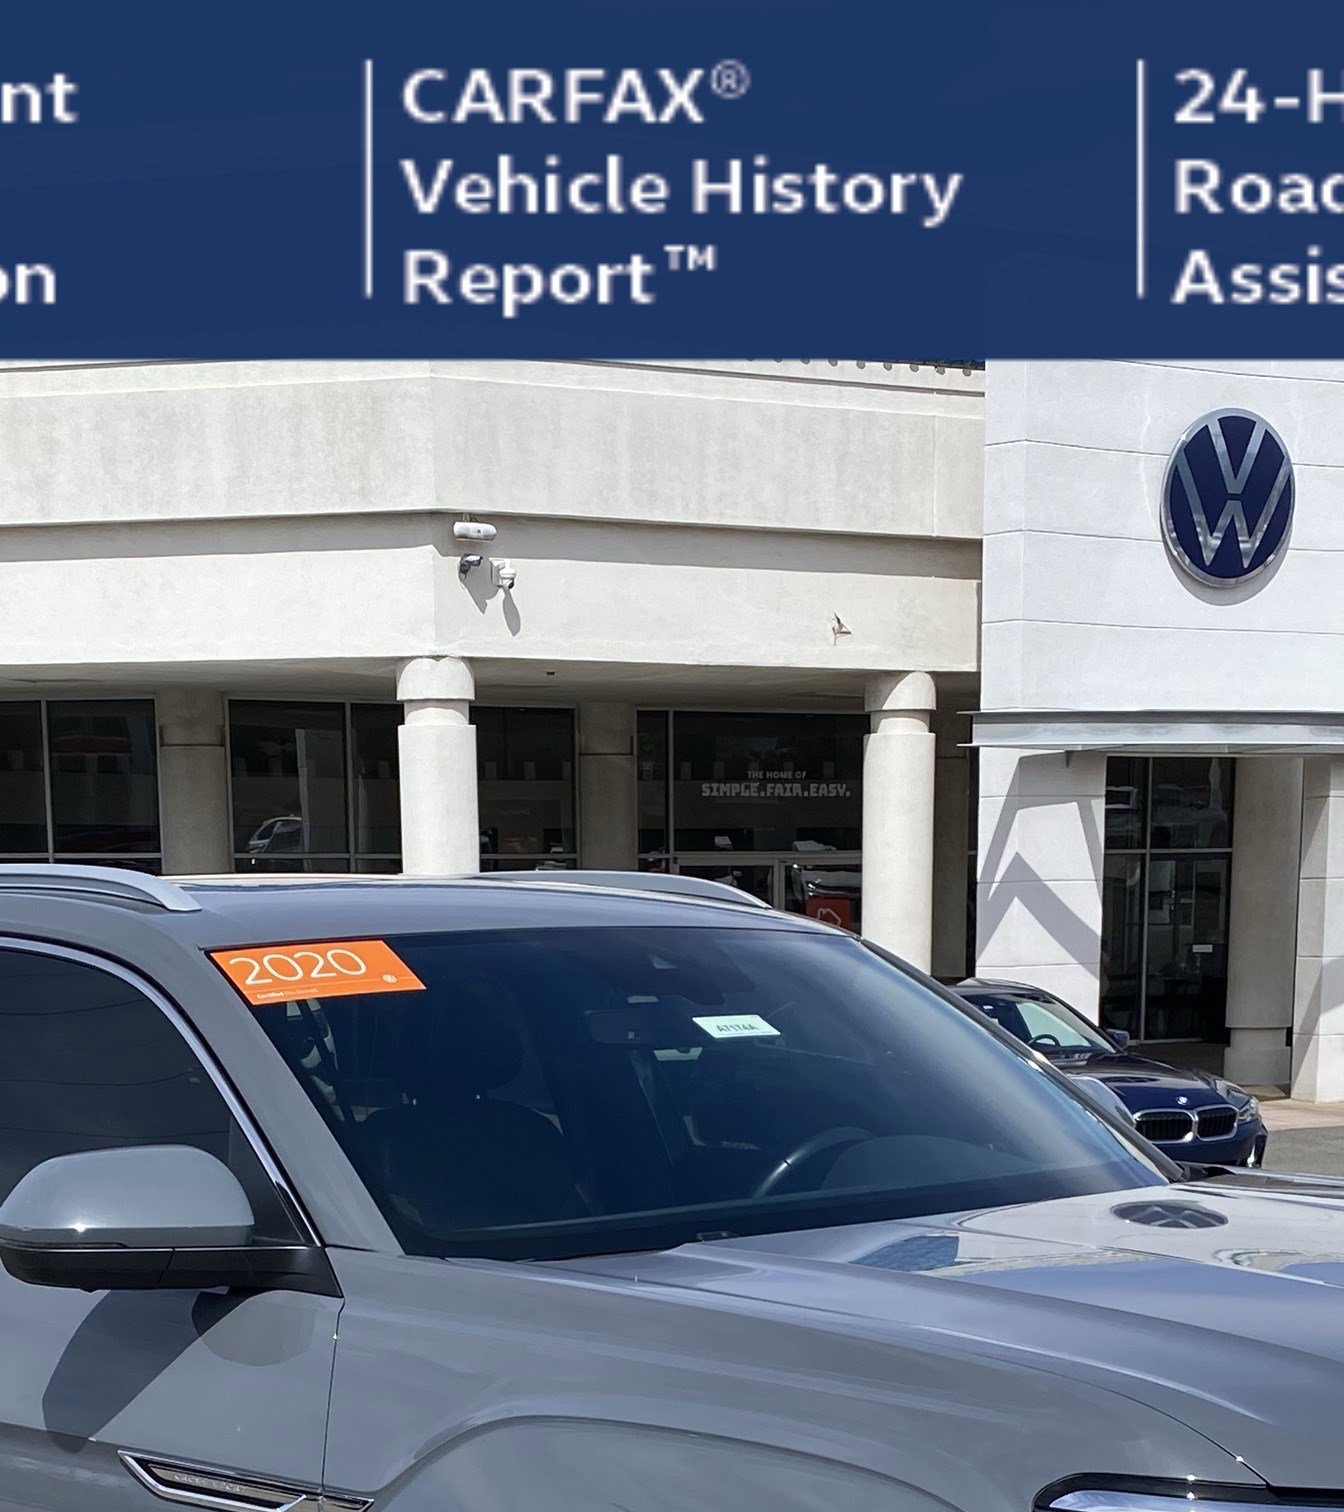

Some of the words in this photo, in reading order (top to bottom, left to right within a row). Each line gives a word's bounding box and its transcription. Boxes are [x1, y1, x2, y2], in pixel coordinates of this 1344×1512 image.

[1164, 409, 1295, 575] VW
[747, 770, 764, 780] THE
[766, 770, 790, 780] HOME
[794, 770, 807, 780] OF
[228, 948, 367, 986] 2020
